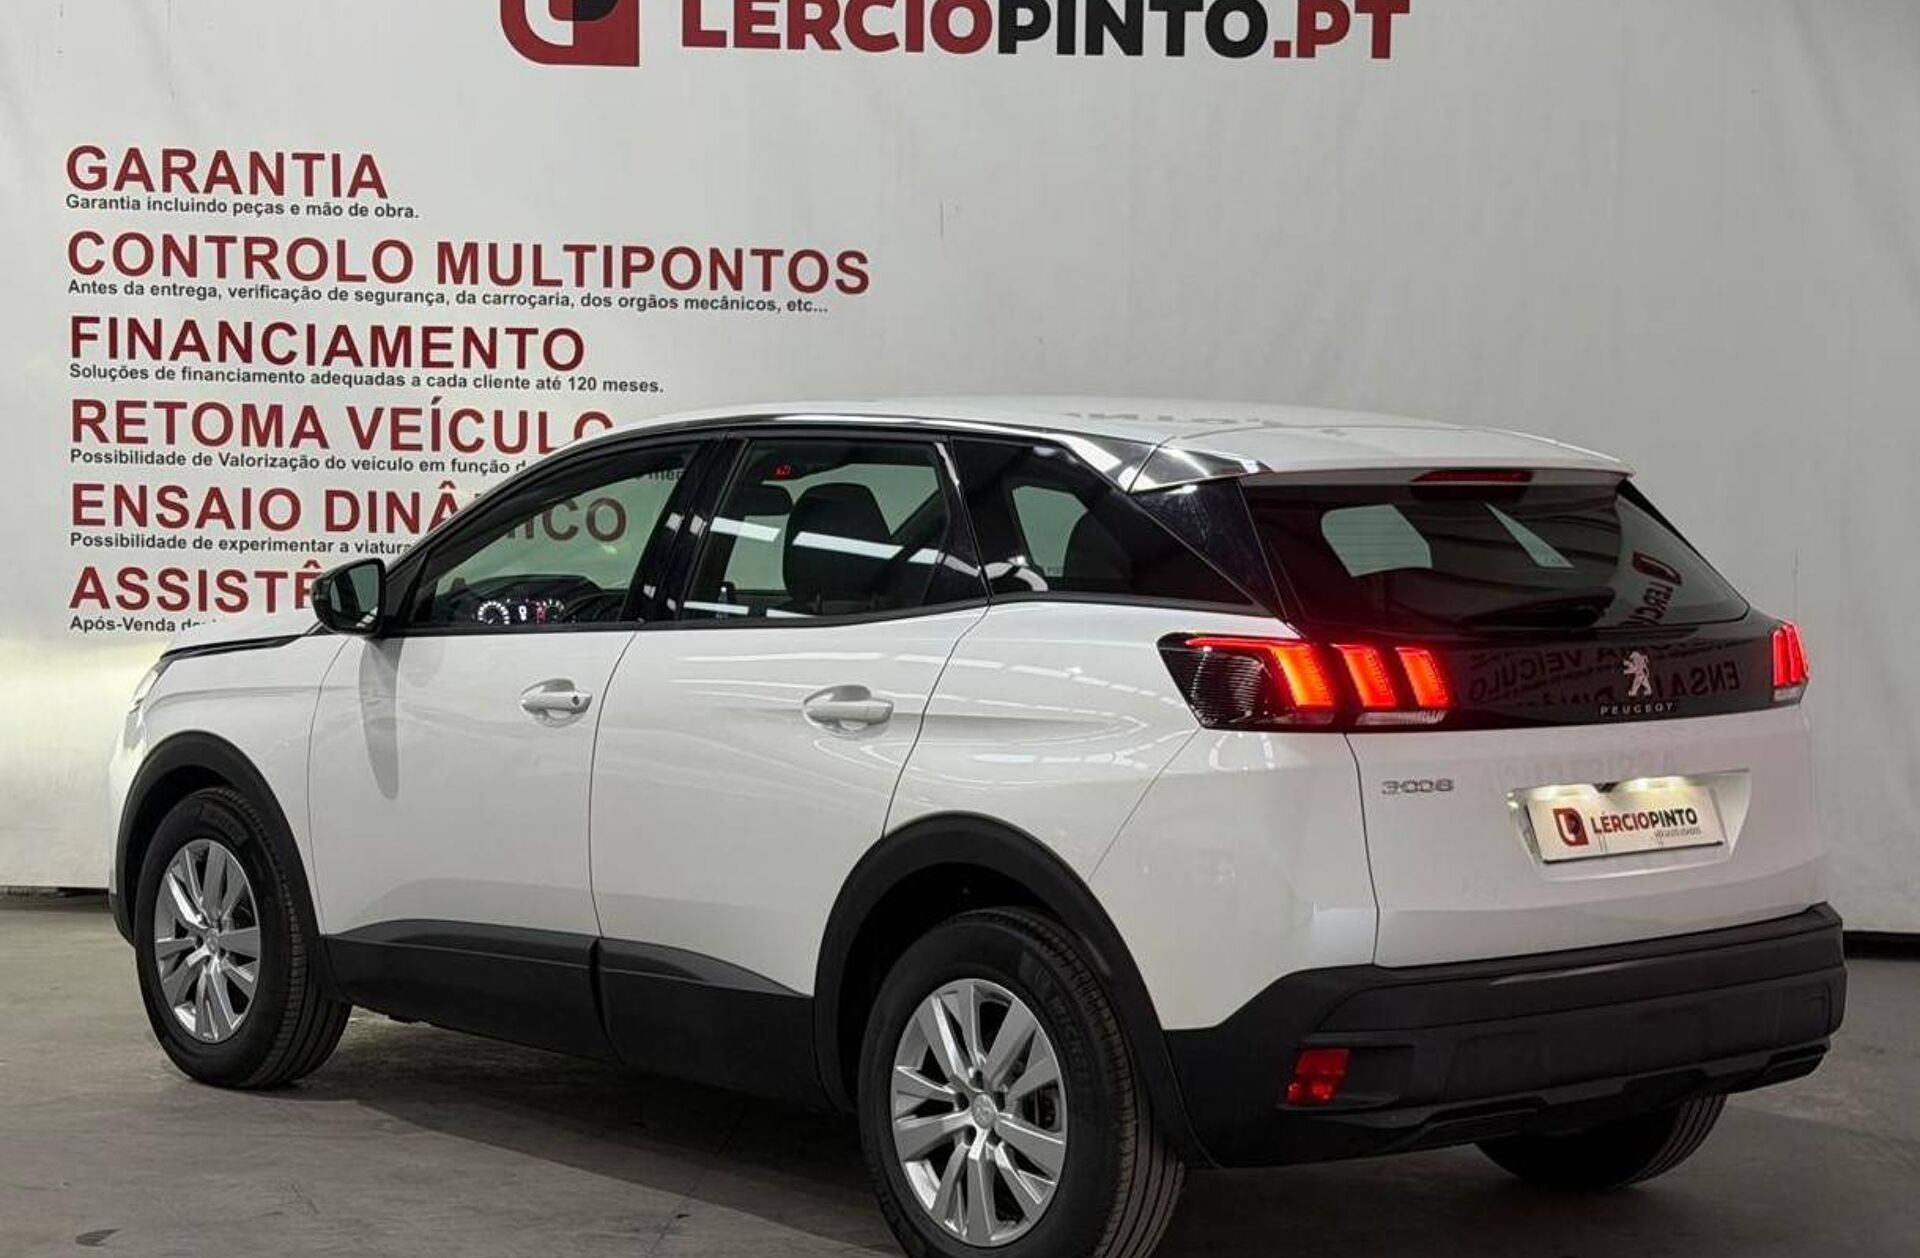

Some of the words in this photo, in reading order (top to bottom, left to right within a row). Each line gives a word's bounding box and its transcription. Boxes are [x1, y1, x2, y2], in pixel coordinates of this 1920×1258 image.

[66, 145, 388, 198] GARANTIA
[65, 193, 141, 211] Garantia
[147, 197, 228, 213] incluindo
[232, 202, 285, 217] peças
[290, 204, 300, 216] e
[306, 204, 343, 217] mão
[348, 204, 369, 217] de
[374, 205, 419, 219] obra.
[68, 231, 414, 284] CONTROLO
[437, 242, 870, 295] MULTIPONTOS
[68, 279, 118, 295] Antes
[123, 280, 145, 296] da
[150, 283, 222, 300] entrega,
[227, 284, 322, 303] verificação
[327, 286, 349, 302] de
[354, 288, 450, 307] segurança,
[455, 289, 477, 305] da
[482, 292, 575, 309] carroçaria,
[580, 293, 613, 308] dos
[618, 294, 679, 312] orgãos
[684, 295, 782, 314] mecânicos,
[786, 298, 829, 314] etc...
[71, 315, 585, 371] FINANCIAMENTO
[69, 362, 149, 383] Soluções
[154, 365, 176, 381] de
[181, 365, 306, 384] financiamento
[310, 370, 406, 389] adequadas
[411, 375, 421, 387] a
[426, 373, 468, 388] cada
[473, 374, 531, 390] cliente
[535, 375, 562, 391] até
[568, 376, 598, 391] 120
[602, 379, 665, 393] meses.
[72, 398, 330, 449] RETOMA
[70, 449, 187, 466] Possibilidade
[191, 452, 213, 467] de
[218, 453, 320, 472] Valorização
[324, 456, 347, 470] do
[419, 459, 446, 472] em
[450, 459, 510, 476] função
[72, 483, 302, 532] ENSAIO
[325, 480, 627, 542] DINÂICO
[70, 532, 187, 550] Possibilidade
[192, 535, 214, 550] de
[218, 537, 335, 554] experimentar
[339, 541, 350, 553] a
[70, 615, 176, 633] Após-Venda
